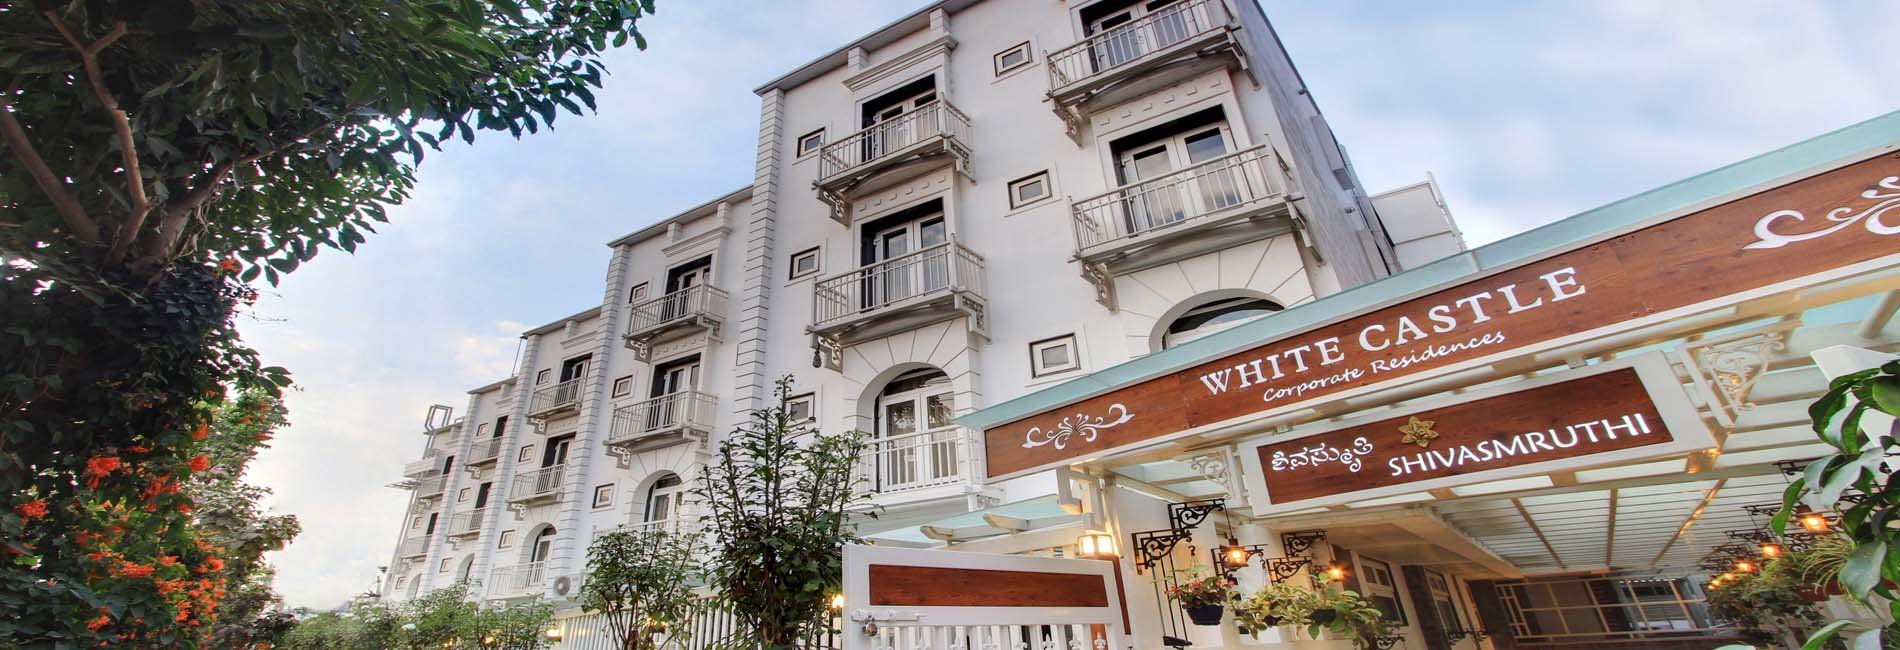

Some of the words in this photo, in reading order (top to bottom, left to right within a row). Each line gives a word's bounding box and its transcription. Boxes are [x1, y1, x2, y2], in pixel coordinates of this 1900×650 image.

[1200, 337, 1345, 395] WHITE
[1359, 266, 1586, 352] CASTLE
[1264, 368, 1365, 402] Corporate
[1371, 331, 1505, 374] Residences
[1389, 413, 1652, 476] SHIVASMRUTHI
